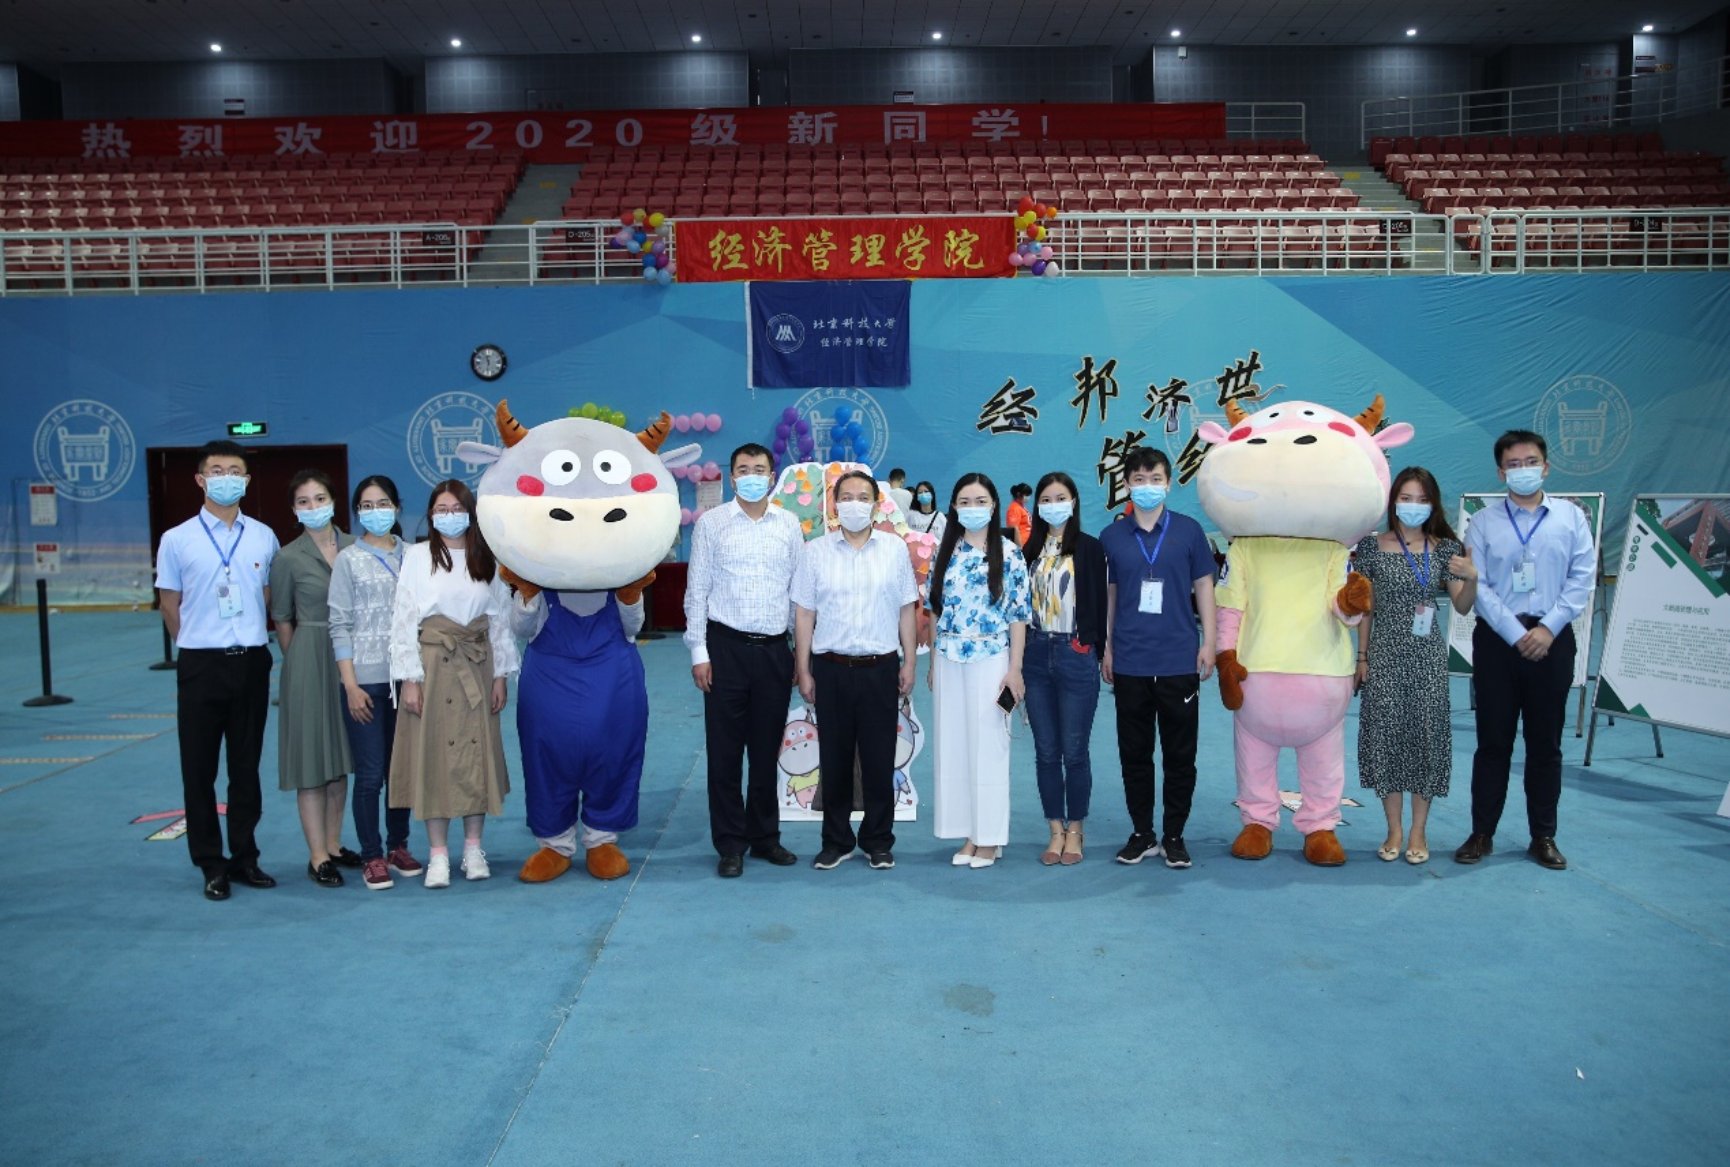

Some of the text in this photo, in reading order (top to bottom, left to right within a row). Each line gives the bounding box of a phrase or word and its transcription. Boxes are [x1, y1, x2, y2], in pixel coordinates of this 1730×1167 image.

[708, 225, 984, 273] 经济管理学院
[813, 316, 896, 331] 北京科技大学
[820, 336, 888, 348] 经济管理学院
[977, 350, 1263, 434] 经邦济世
